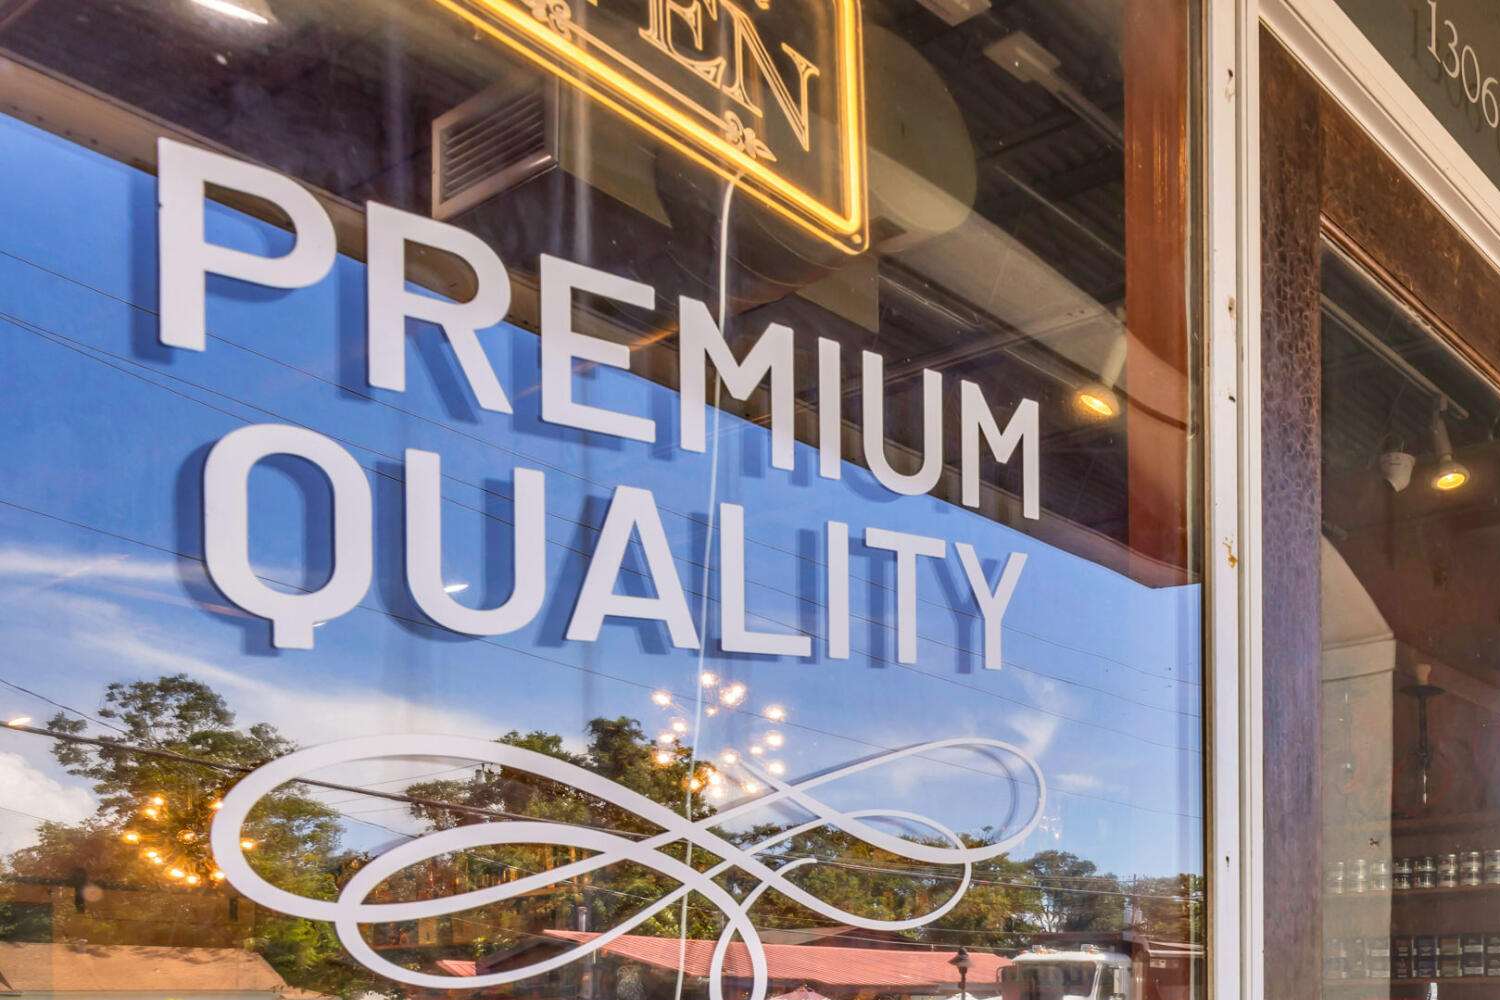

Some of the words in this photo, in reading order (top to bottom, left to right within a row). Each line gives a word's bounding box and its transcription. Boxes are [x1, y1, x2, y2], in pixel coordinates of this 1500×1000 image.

[637, 0, 820, 152] EN
[1426, 0, 1500, 129] 1306
[158, 137, 1040, 520] PREMIUM
[204, 423, 1028, 671] QUALITY
